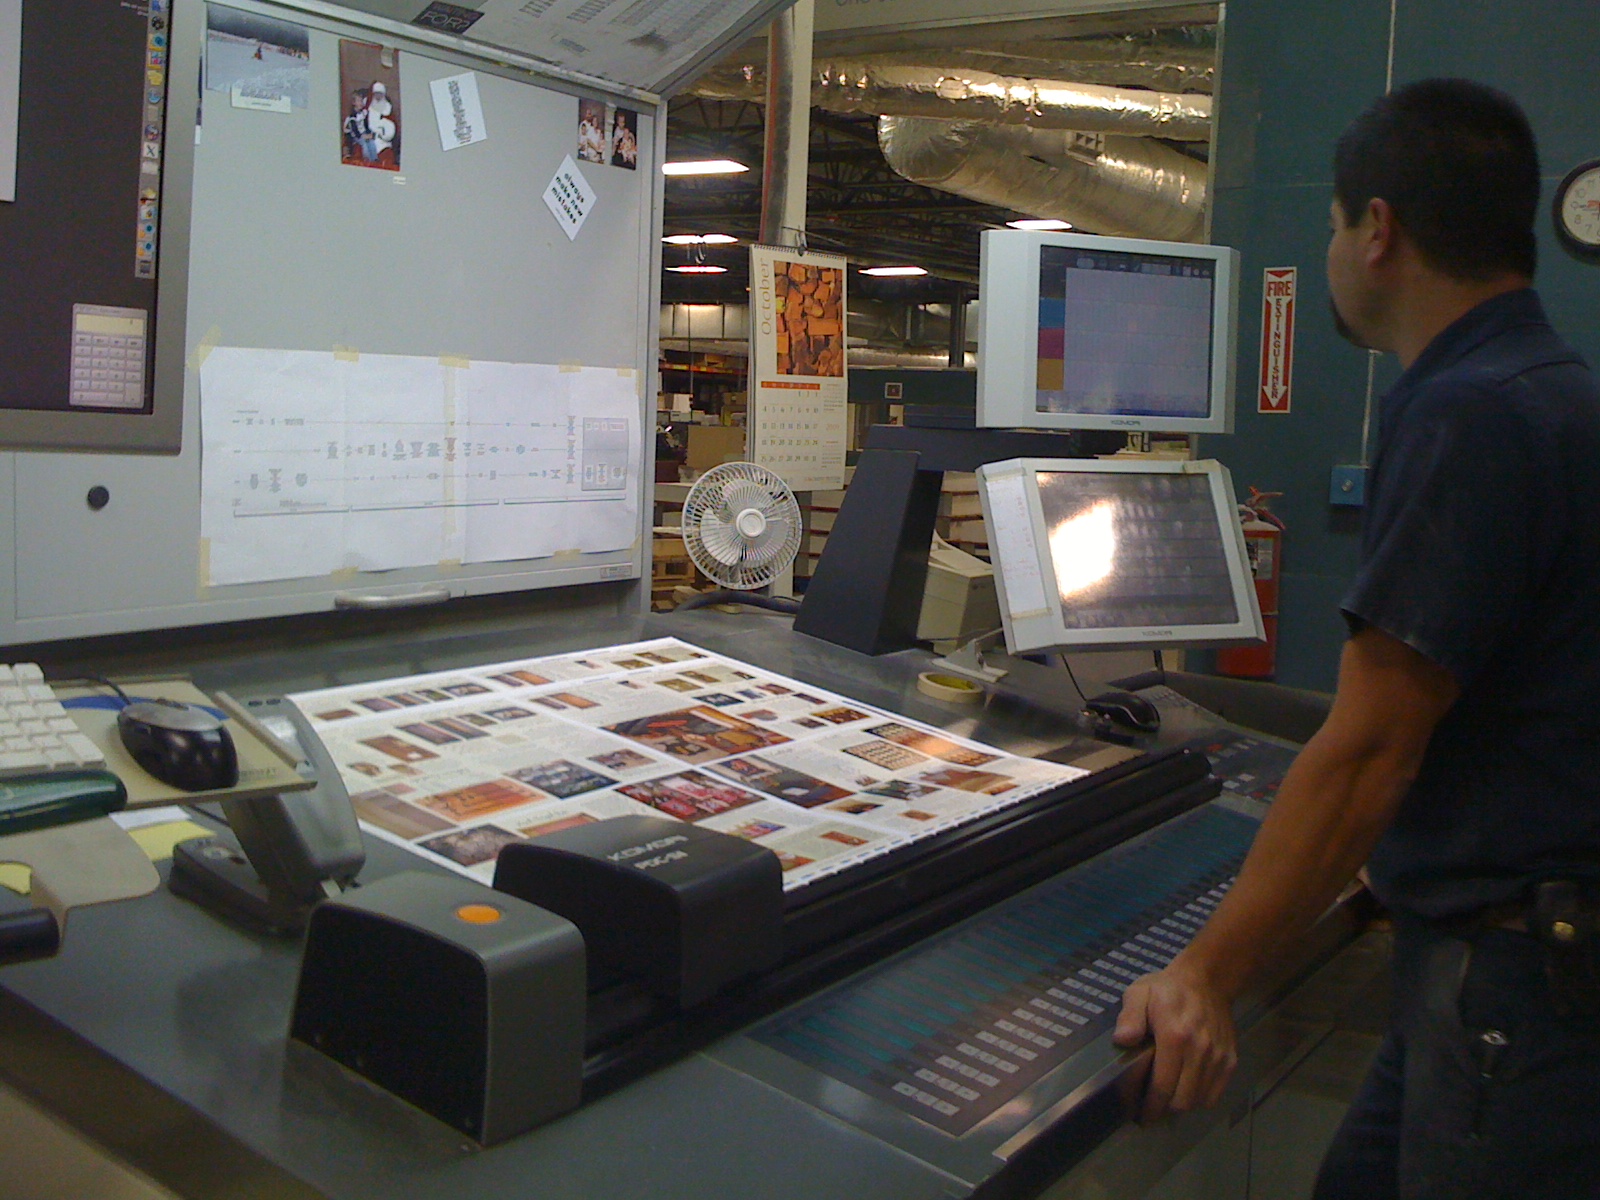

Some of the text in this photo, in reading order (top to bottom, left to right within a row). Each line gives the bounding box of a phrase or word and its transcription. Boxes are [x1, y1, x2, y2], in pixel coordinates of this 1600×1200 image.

[420, 10, 471, 30] FOR?
[551, 187, 577, 224] mistakes
[555, 176, 571, 198] make
[570, 199, 583, 216] new
[563, 173, 585, 203] always
[759, 257, 772, 335] October
[1266, 280, 1293, 297] FIRE
[1271, 298, 1282, 399] EXTINGUISHER
